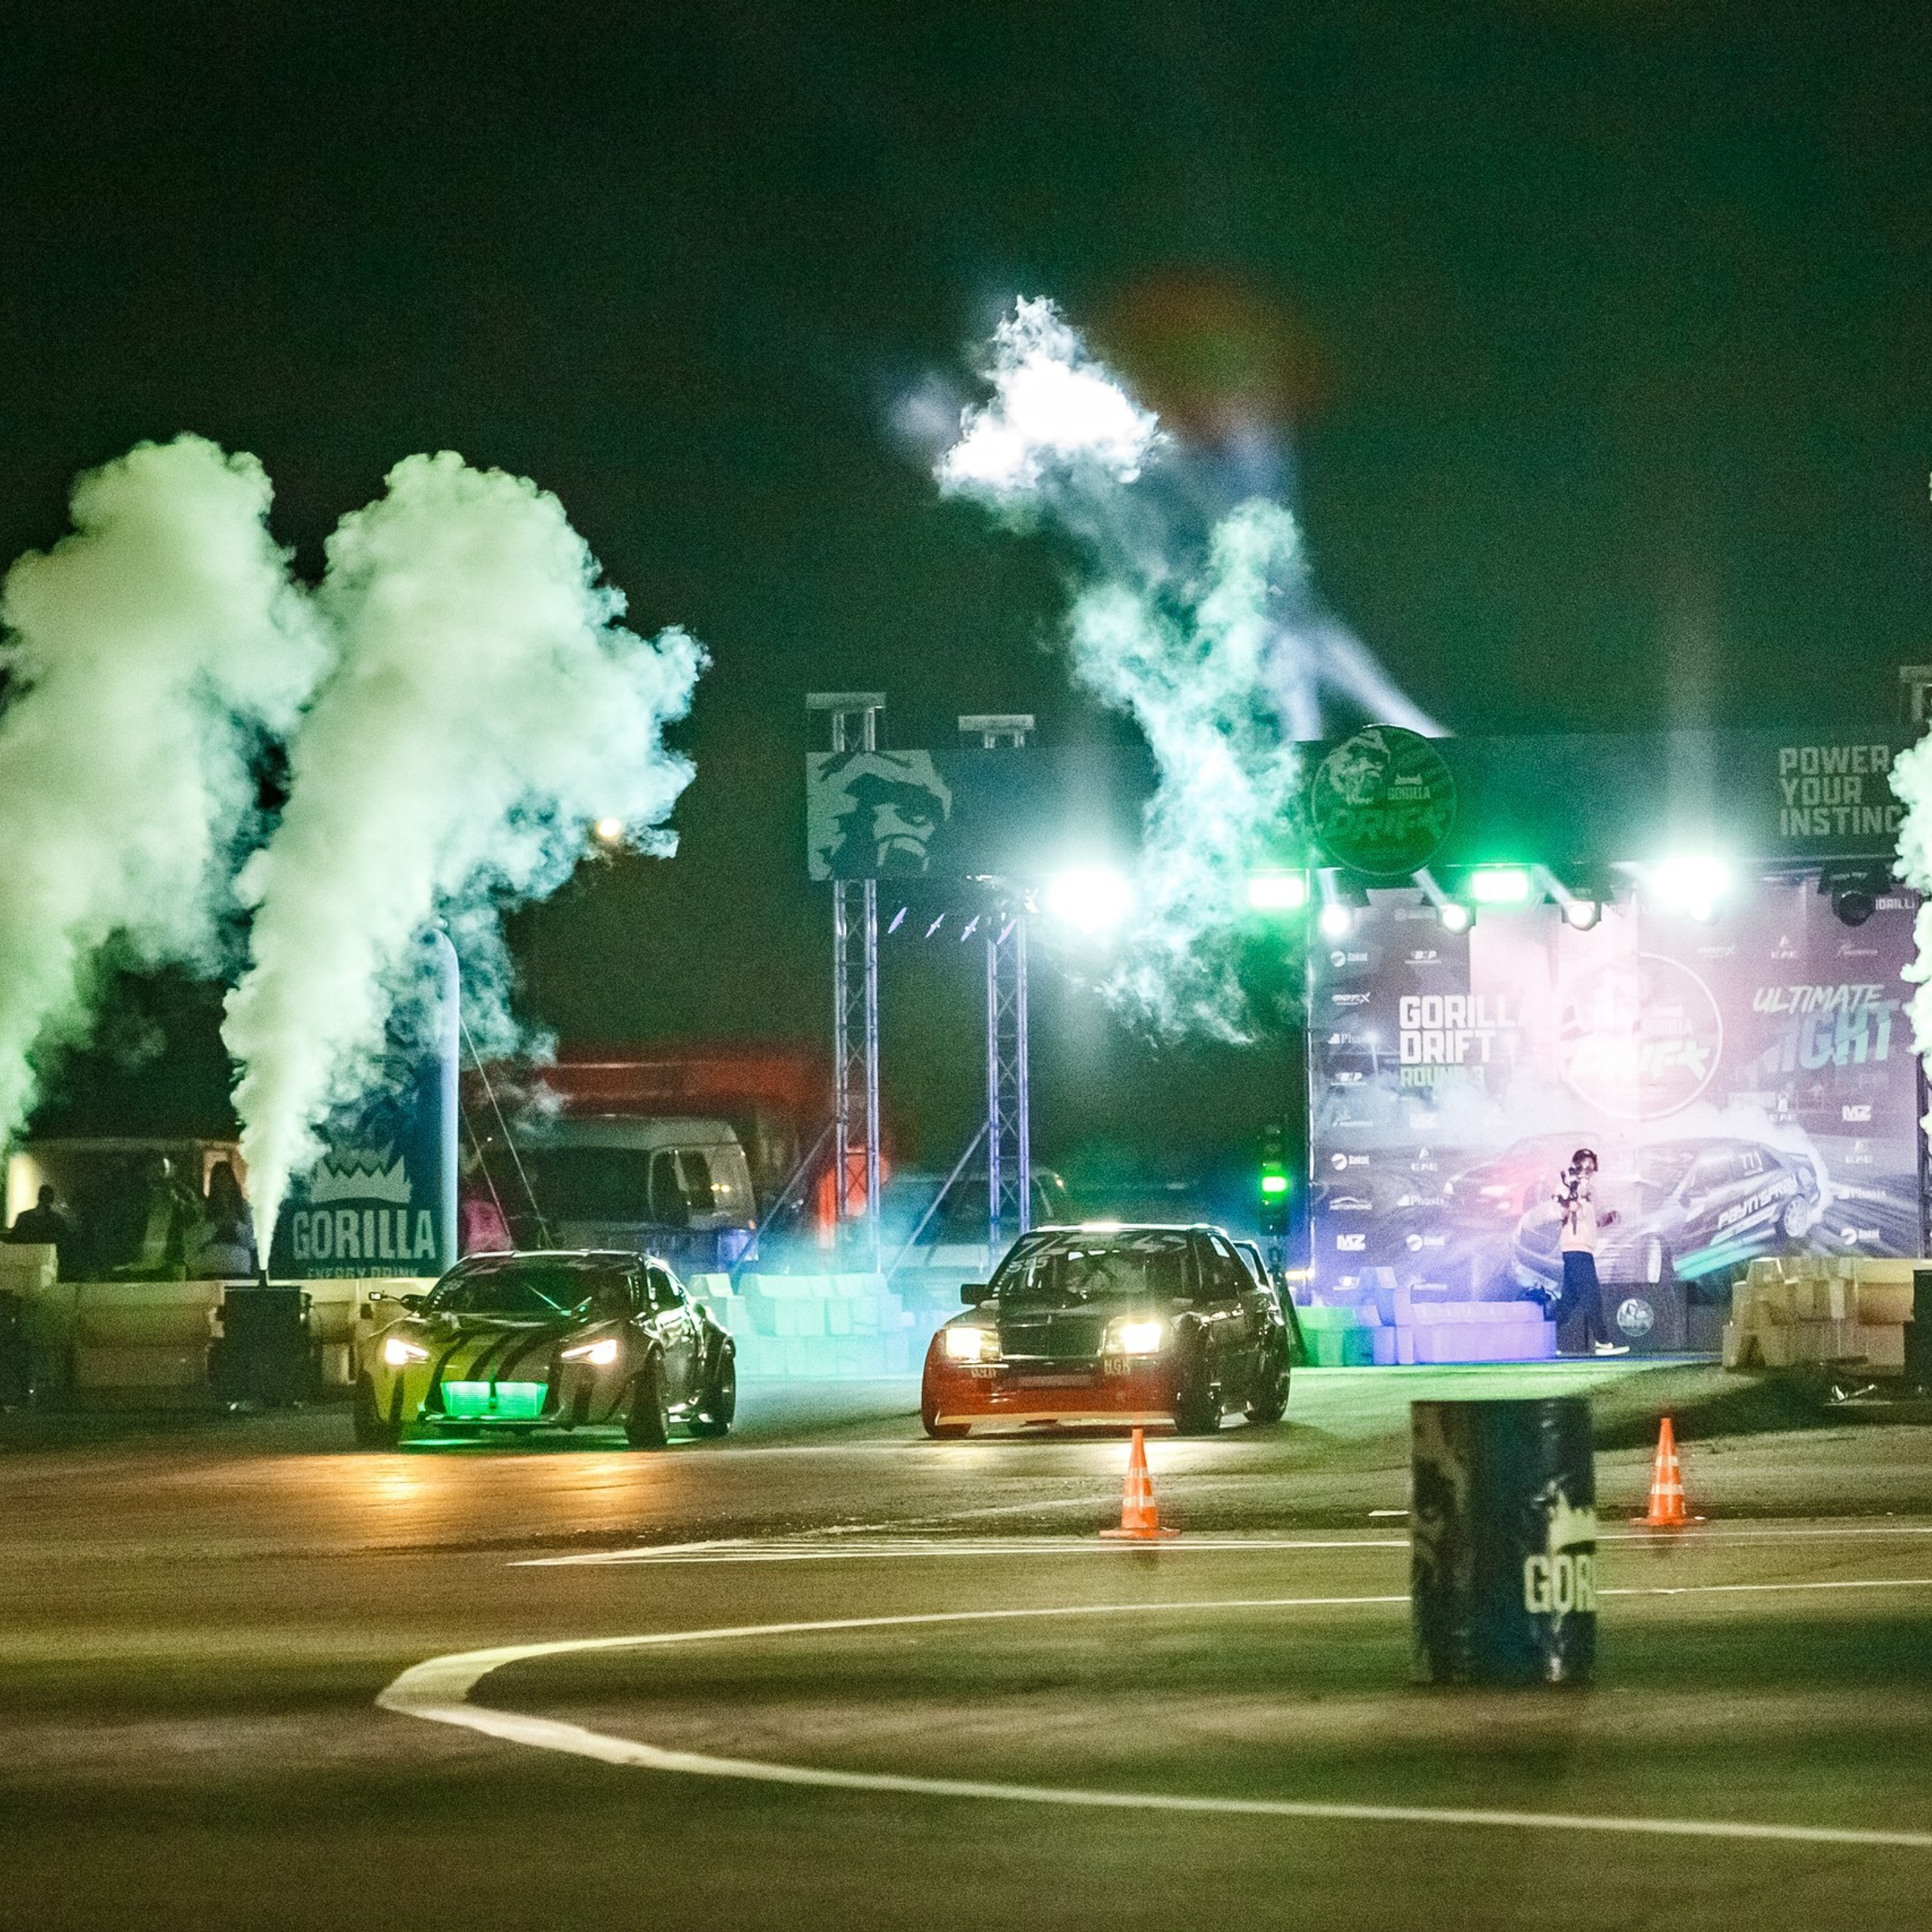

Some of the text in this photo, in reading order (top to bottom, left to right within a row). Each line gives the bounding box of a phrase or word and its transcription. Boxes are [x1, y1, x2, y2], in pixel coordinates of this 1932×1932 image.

[1779, 745, 1889, 775] POWER
[1780, 776, 1862, 806] YOUR
[1780, 804, 1903, 836] INSTINC
[1875, 898, 1915, 910] ORILL
[1753, 984, 1887, 1014] ULTIMATE
[1399, 1029, 1497, 1064] DRIFT
[292, 1210, 436, 1260] GORILLA
[1524, 1555, 1597, 1614] GOR
